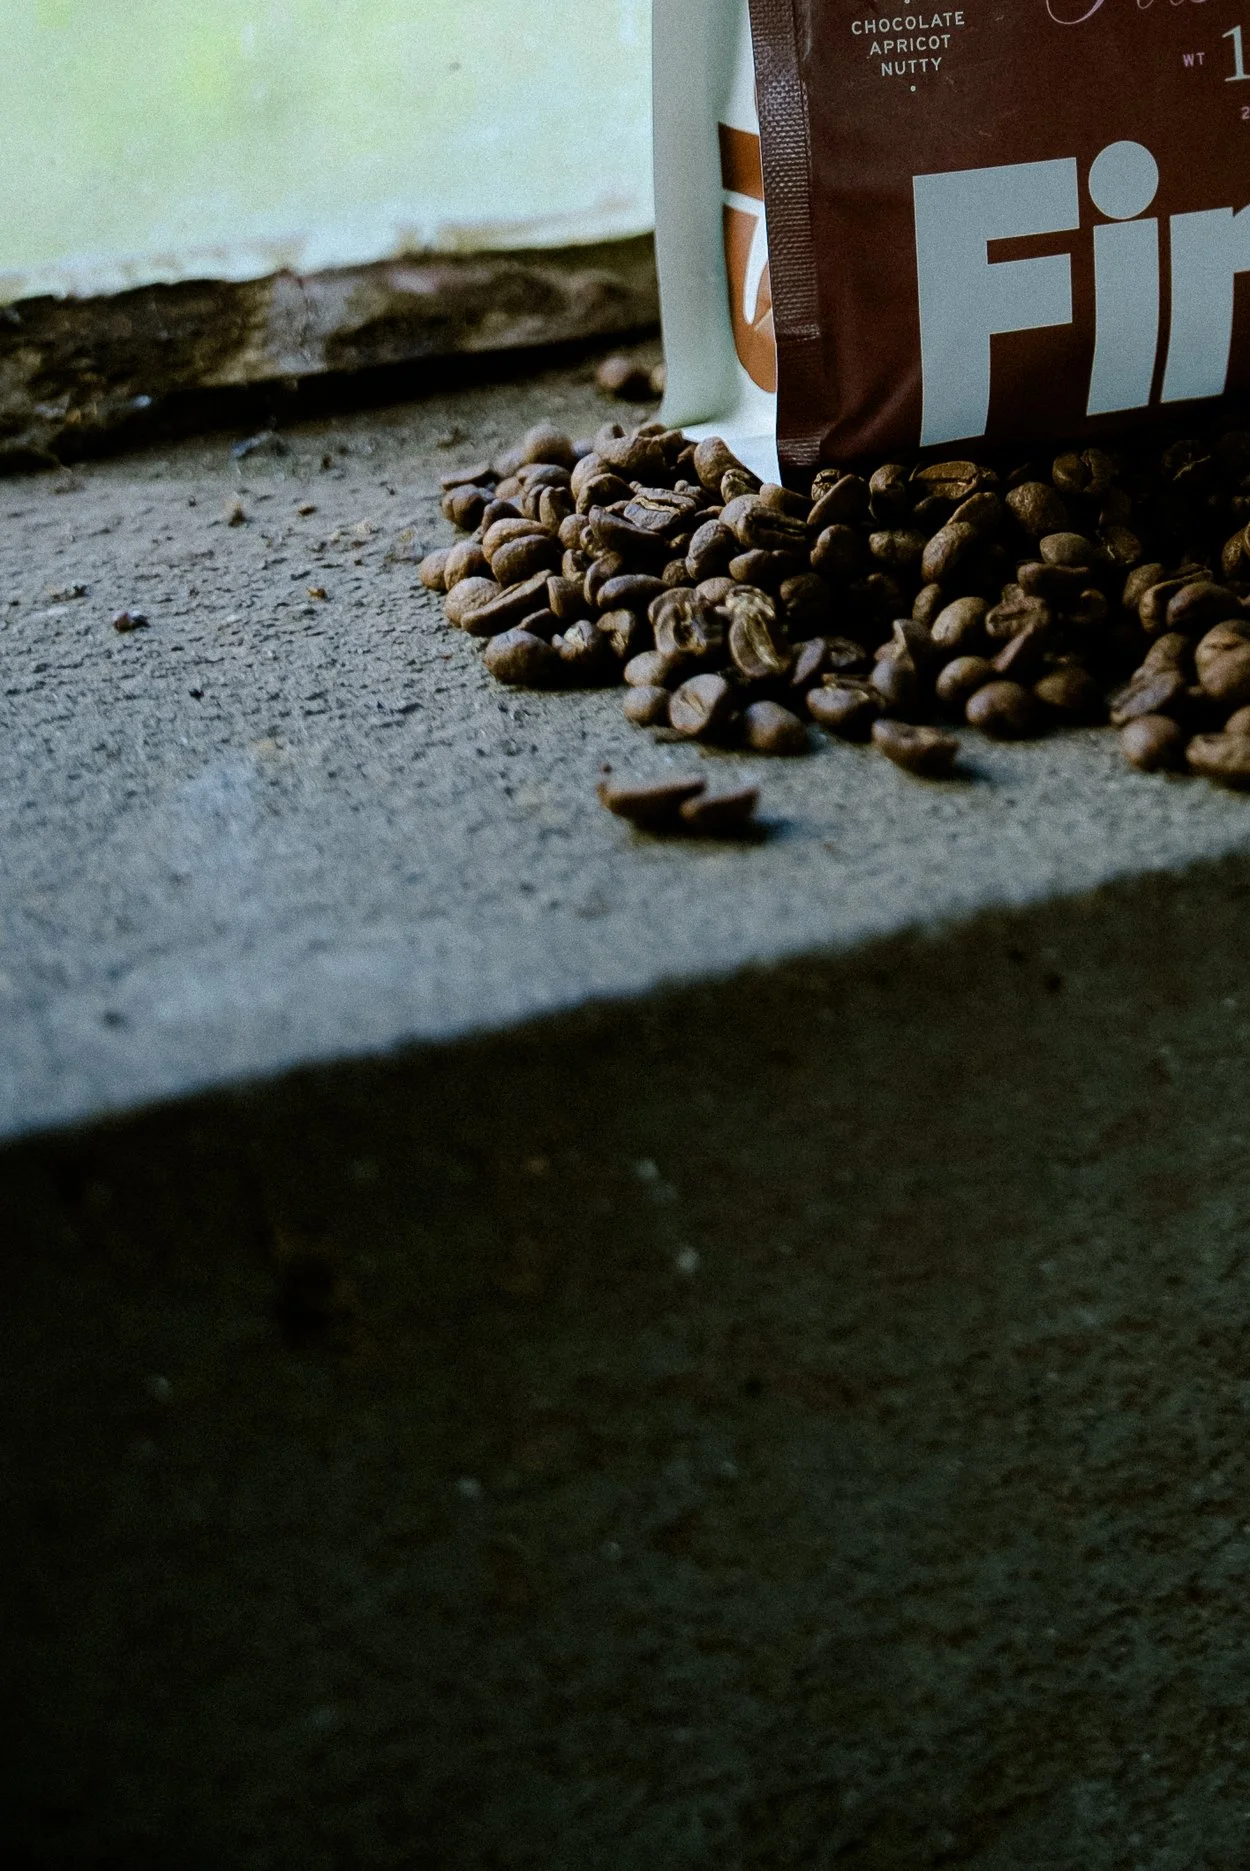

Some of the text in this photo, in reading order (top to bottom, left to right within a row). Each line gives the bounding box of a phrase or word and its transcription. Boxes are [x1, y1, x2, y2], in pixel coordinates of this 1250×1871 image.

[851, 11, 966, 35] CHOCOLATE
[869, 34, 951, 56] APRICOT
[881, 57, 942, 77] NUTTY
[1182, 52, 1205, 68] WT
